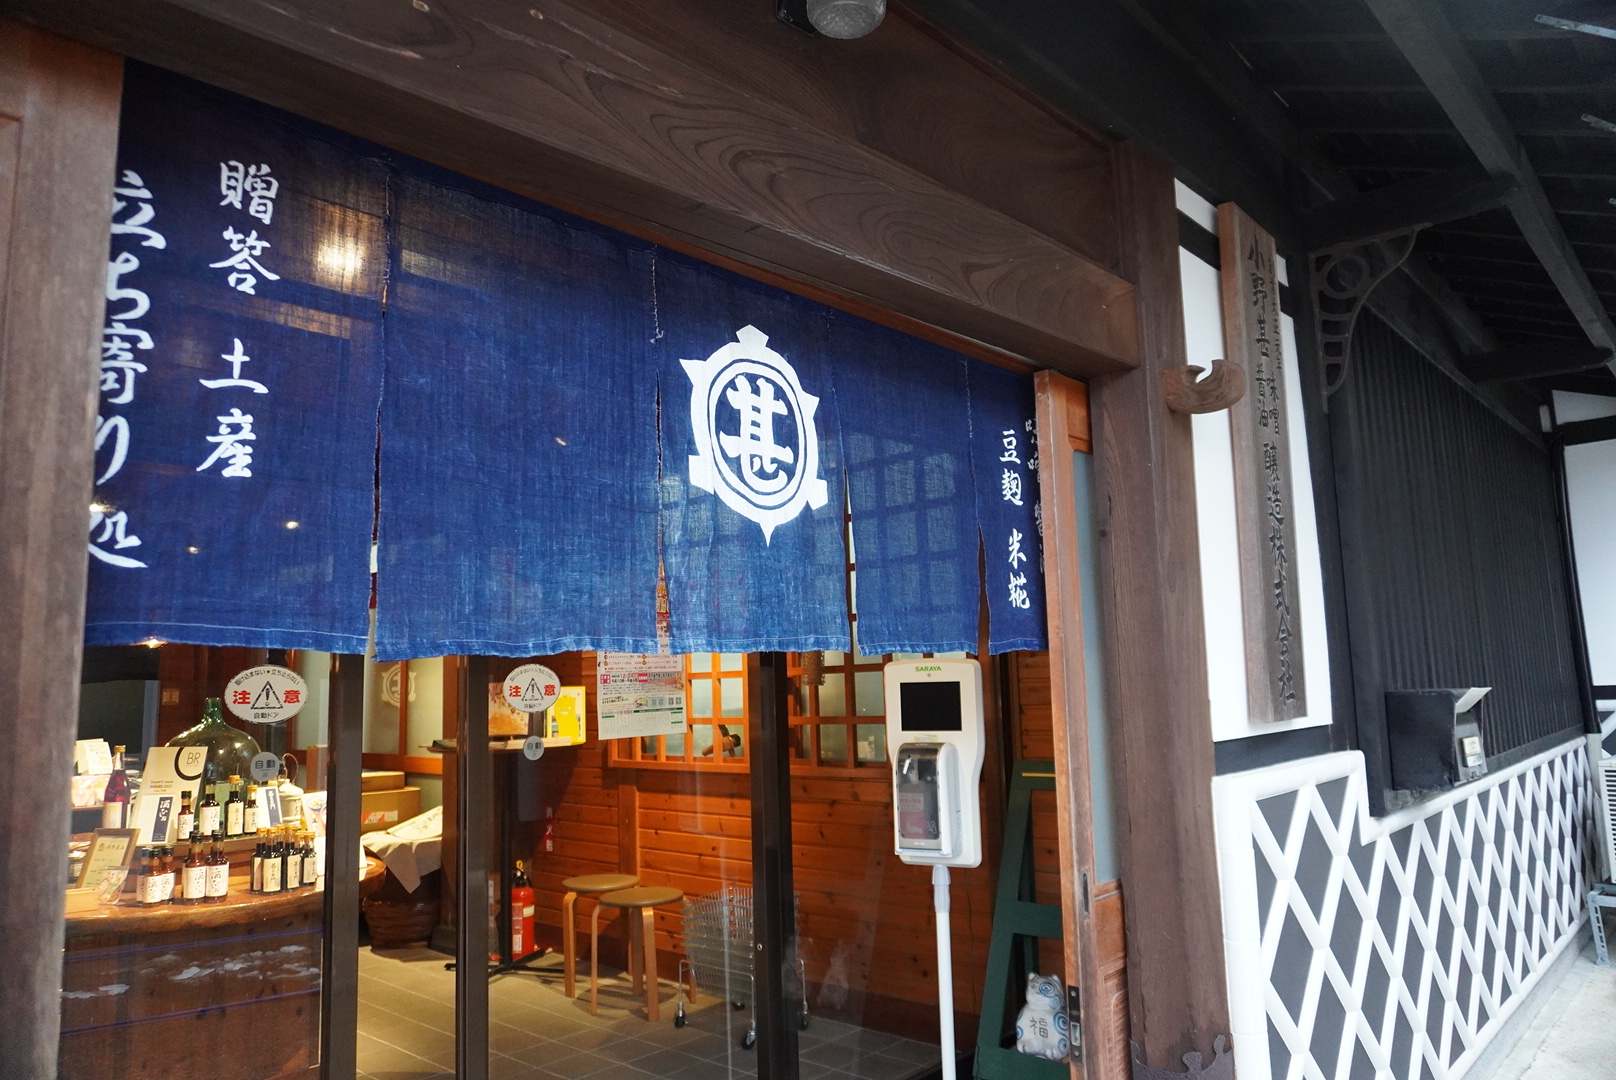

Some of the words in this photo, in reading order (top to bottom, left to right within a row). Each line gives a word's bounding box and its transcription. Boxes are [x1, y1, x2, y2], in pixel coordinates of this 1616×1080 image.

[209, 160, 280, 295] 贈答
[196, 338, 269, 478] 土産
[1008, 528, 1031, 609] 米糀
[232, 690, 251, 705] 注
[283, 689, 301, 704] 意
[508, 685, 522, 697] 注
[543, 684, 556, 696] 意
[527, 742, 541, 750] 自動
[186, 752, 201, 765] BR
[255, 759, 276, 769] 自動
[1029, 1017, 1049, 1039] 福
